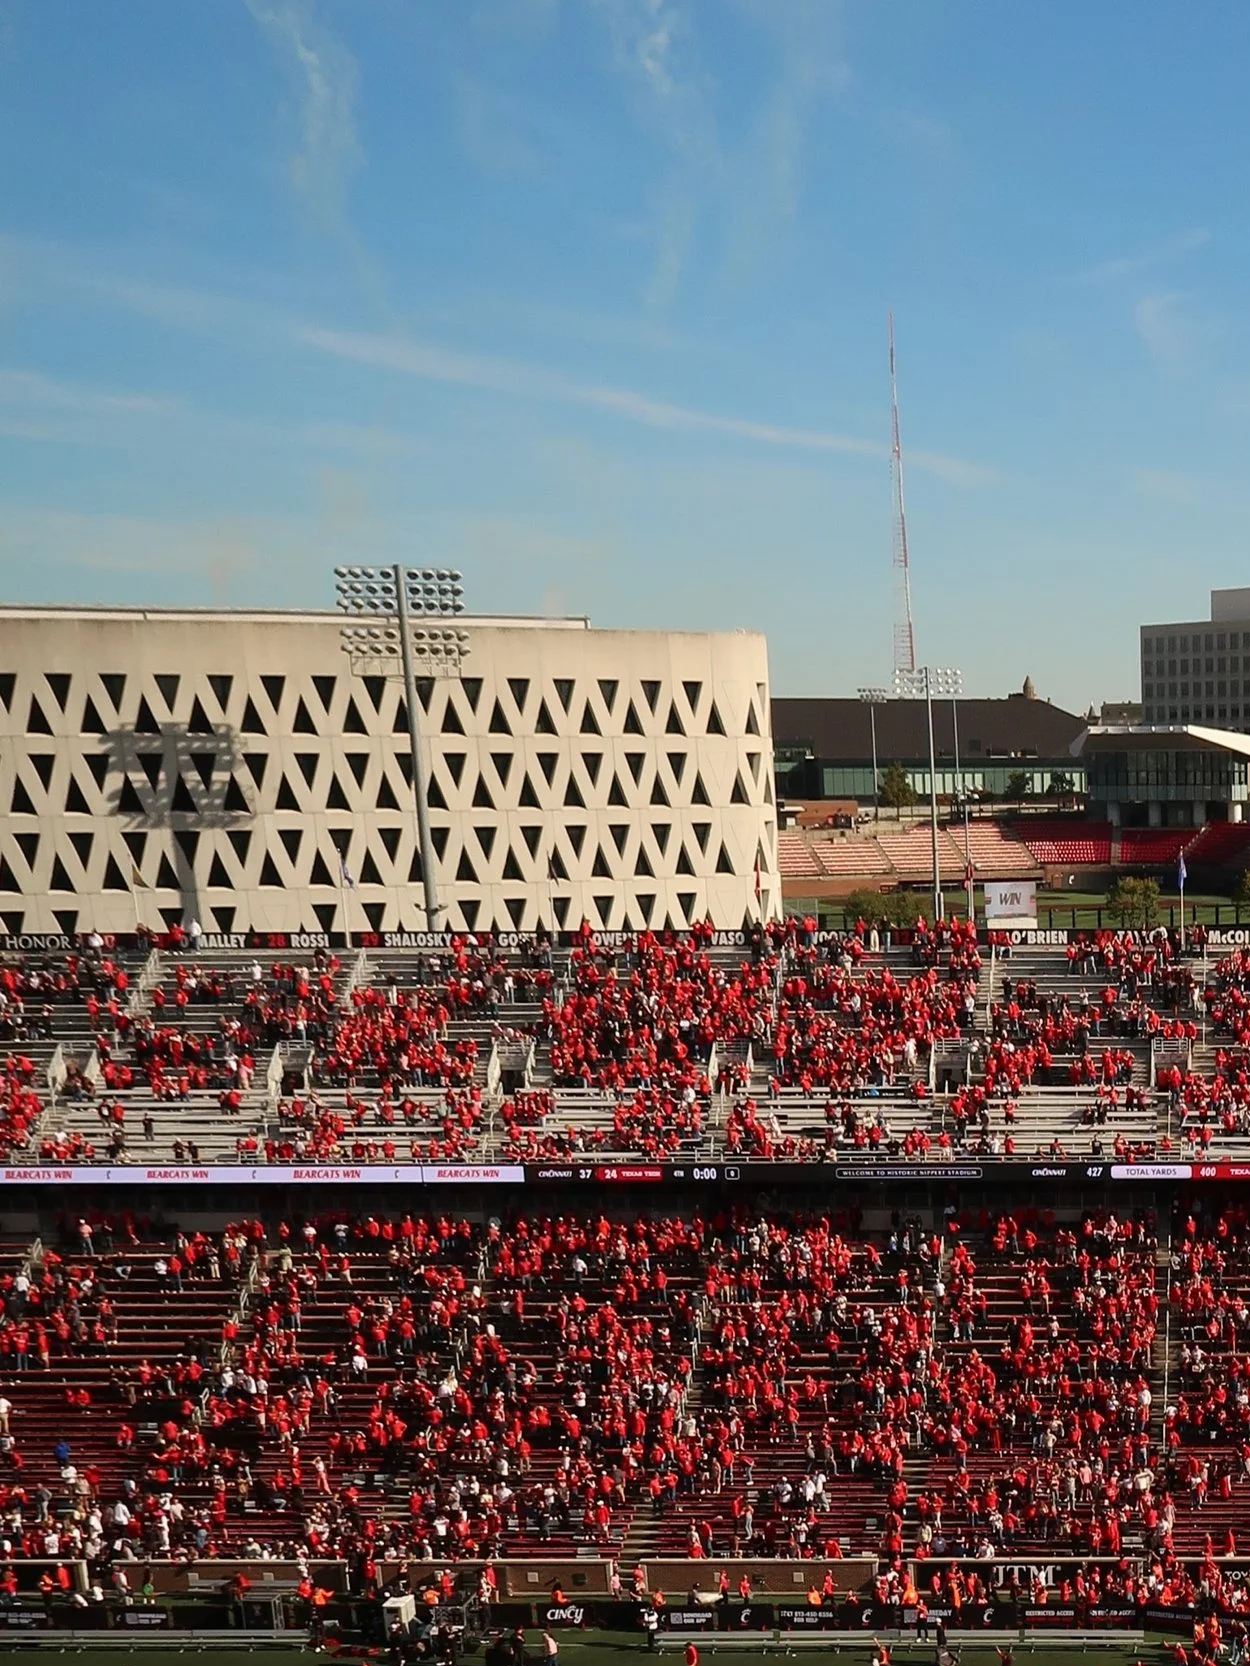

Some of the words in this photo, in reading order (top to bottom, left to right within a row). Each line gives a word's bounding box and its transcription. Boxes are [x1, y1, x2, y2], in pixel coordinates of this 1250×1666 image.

[999, 892, 1022, 906] WIN
[5, 935, 73, 949] HONOR
[267, 934, 287, 947] 28
[290, 934, 329, 947] ROSSI
[384, 933, 452, 946] SHALOSKY
[1012, 931, 1068, 944] O'BRIEN
[5, 1171, 51, 1179] BEARCATS
[54, 1171, 72, 1179] WIN
[147, 1170, 190, 1179] BEARCATS
[192, 1170, 209, 1179] WIN
[293, 1170, 340, 1179] BEARCATS
[342, 1170, 361, 1179] WIN
[437, 1169, 480, 1178] BEARCATS
[482, 1169, 500, 1178] WIN
[579, 1169, 592, 1179] 37
[604, 1169, 618, 1179] 24
[692, 1168, 717, 1179] 0:00
[1086, 1167, 1103, 1177] 427
[1126, 1168, 1149, 1176] TOTAL
[1151, 1168, 1177, 1176] YARDS
[1200, 1168, 1216, 1177] 400
[993, 1564, 1057, 1588] JTM
[546, 1605, 584, 1624] CINCY
